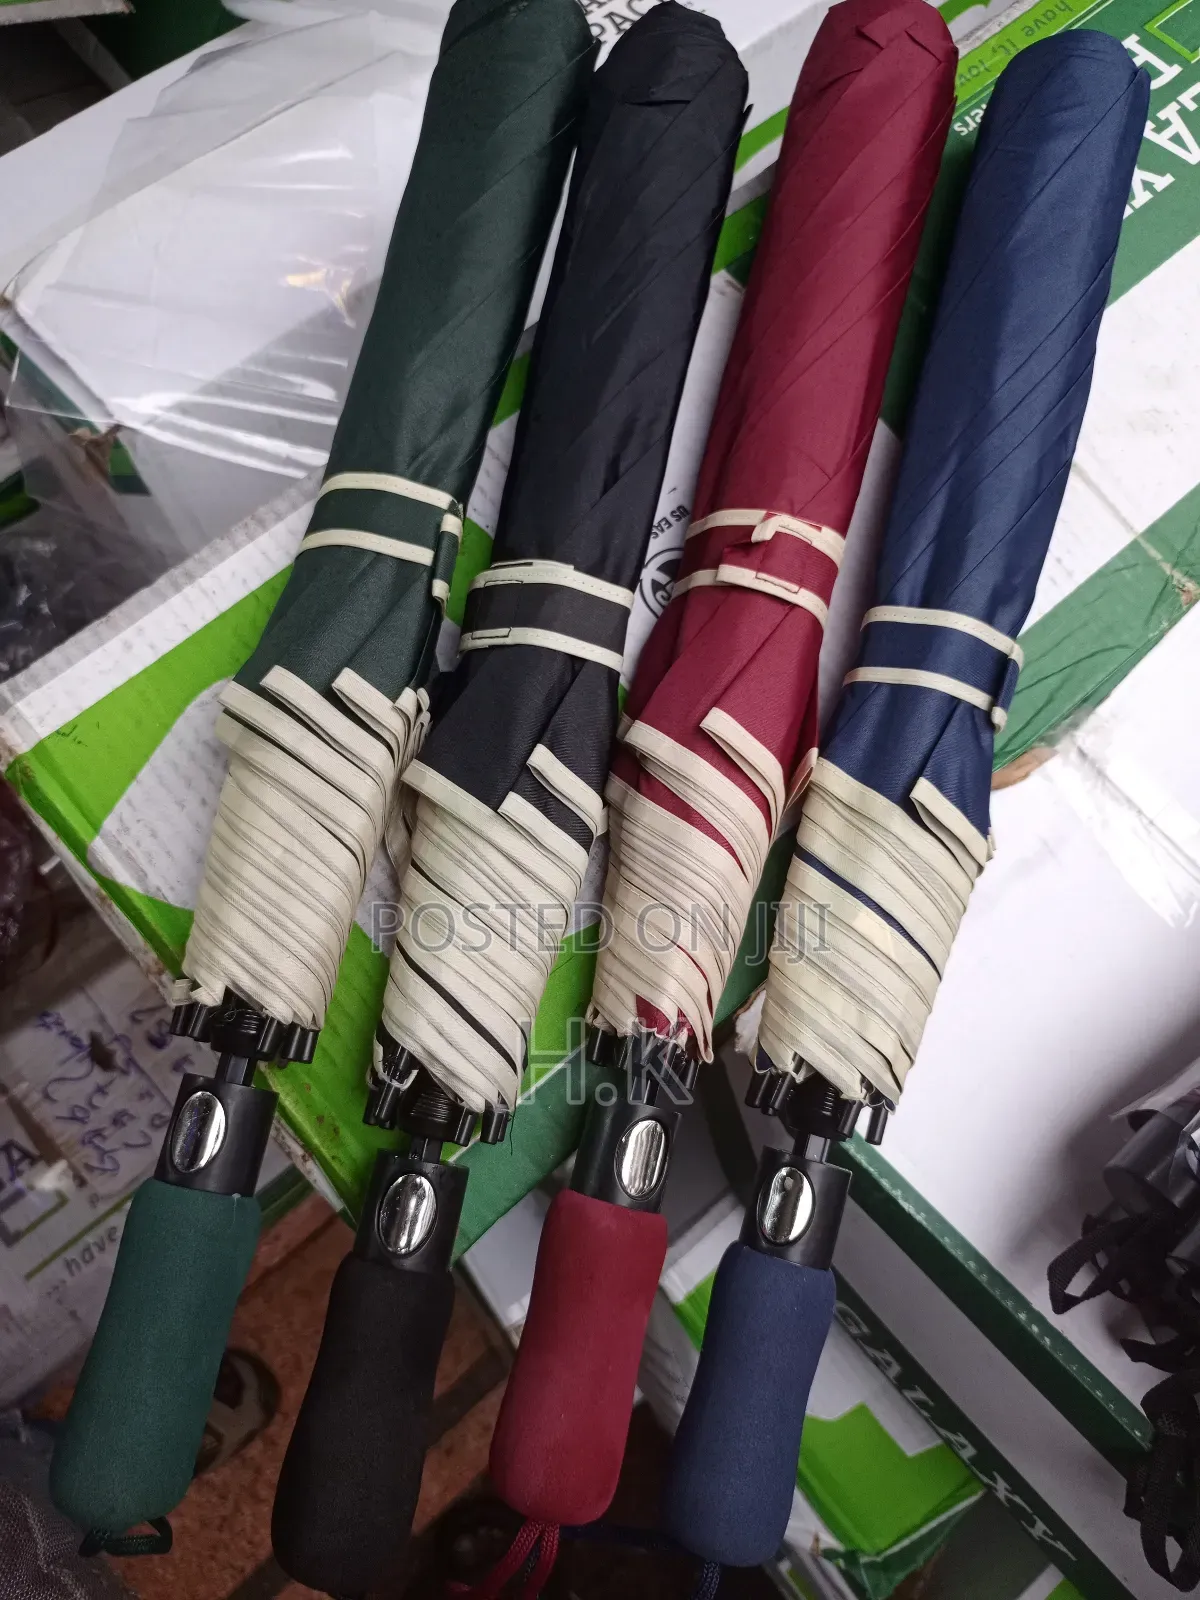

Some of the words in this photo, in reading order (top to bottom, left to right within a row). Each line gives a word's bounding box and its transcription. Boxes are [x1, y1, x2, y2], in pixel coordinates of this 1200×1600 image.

[958, 59, 992, 87] lov
[953, 103, 987, 136] ers
[834, 1302, 1077, 1561] GALAXY
